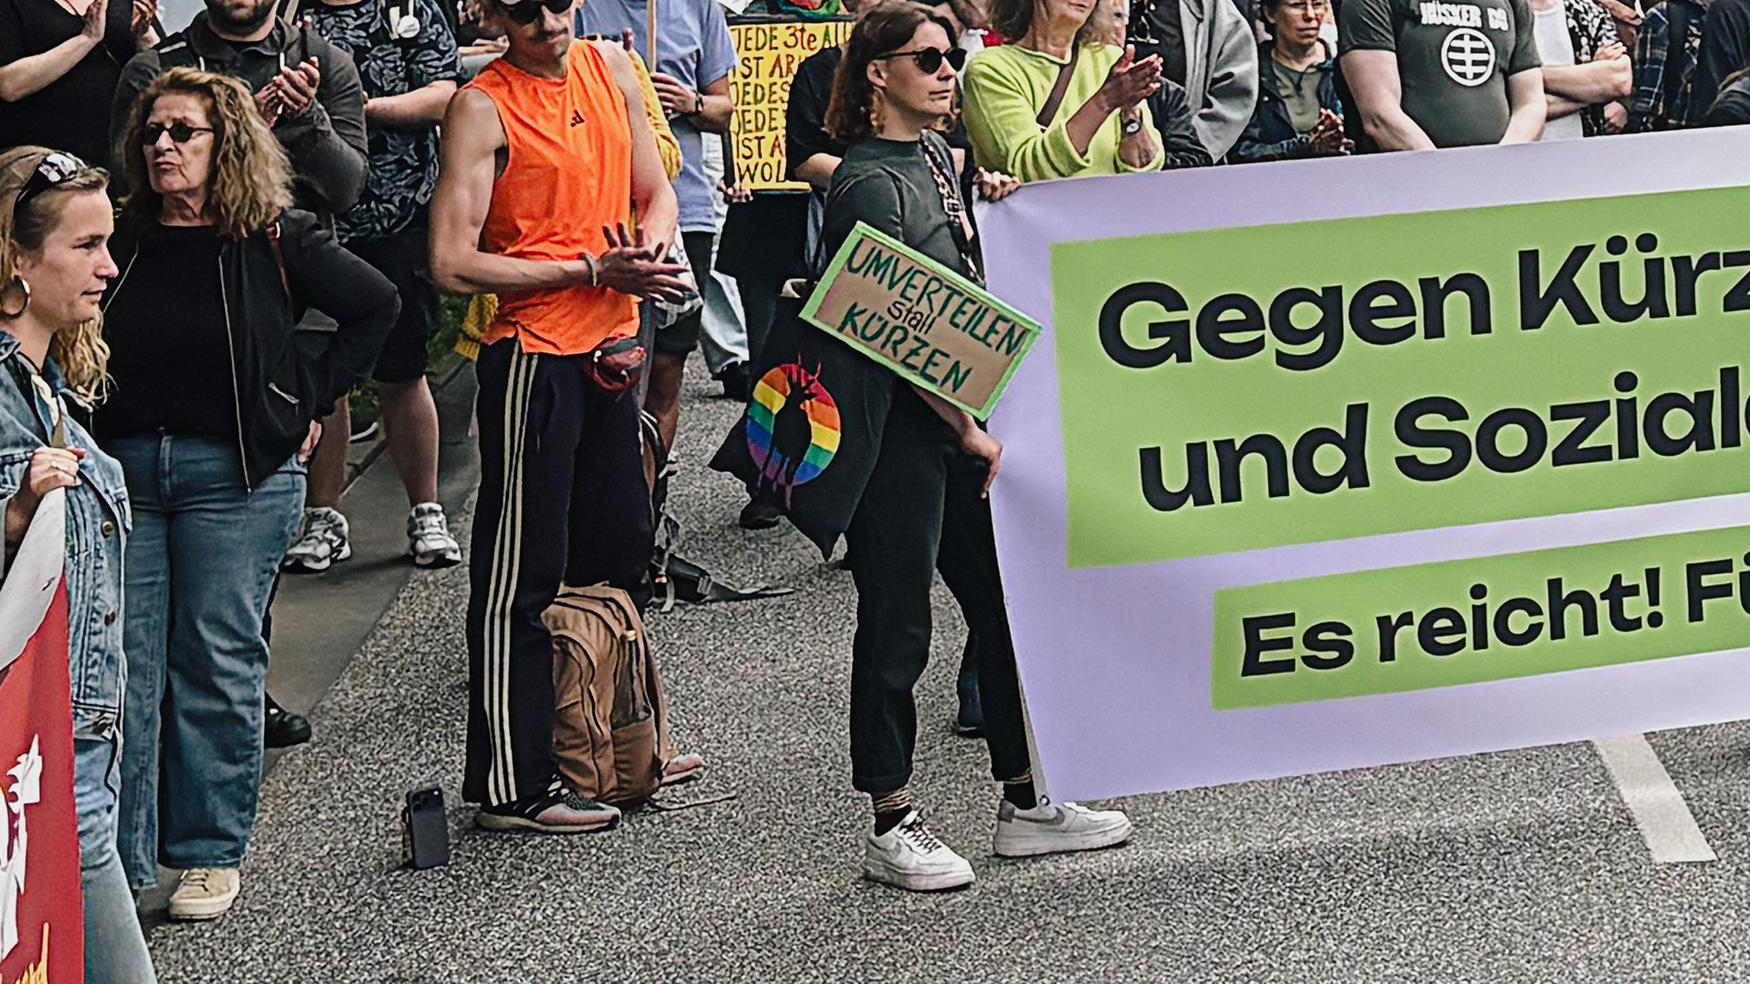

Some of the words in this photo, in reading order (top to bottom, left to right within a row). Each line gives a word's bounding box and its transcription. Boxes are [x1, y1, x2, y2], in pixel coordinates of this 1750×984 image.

[730, 26, 779, 53] JEDE
[837, 302, 973, 393] KÜRZEN
[847, 238, 1026, 356] UMVERTEILEN
[1099, 273, 1492, 370] Gegen
[1138, 402, 1369, 512] und
[1240, 611, 1354, 678] Es
[1376, 565, 1663, 662] reicht!
